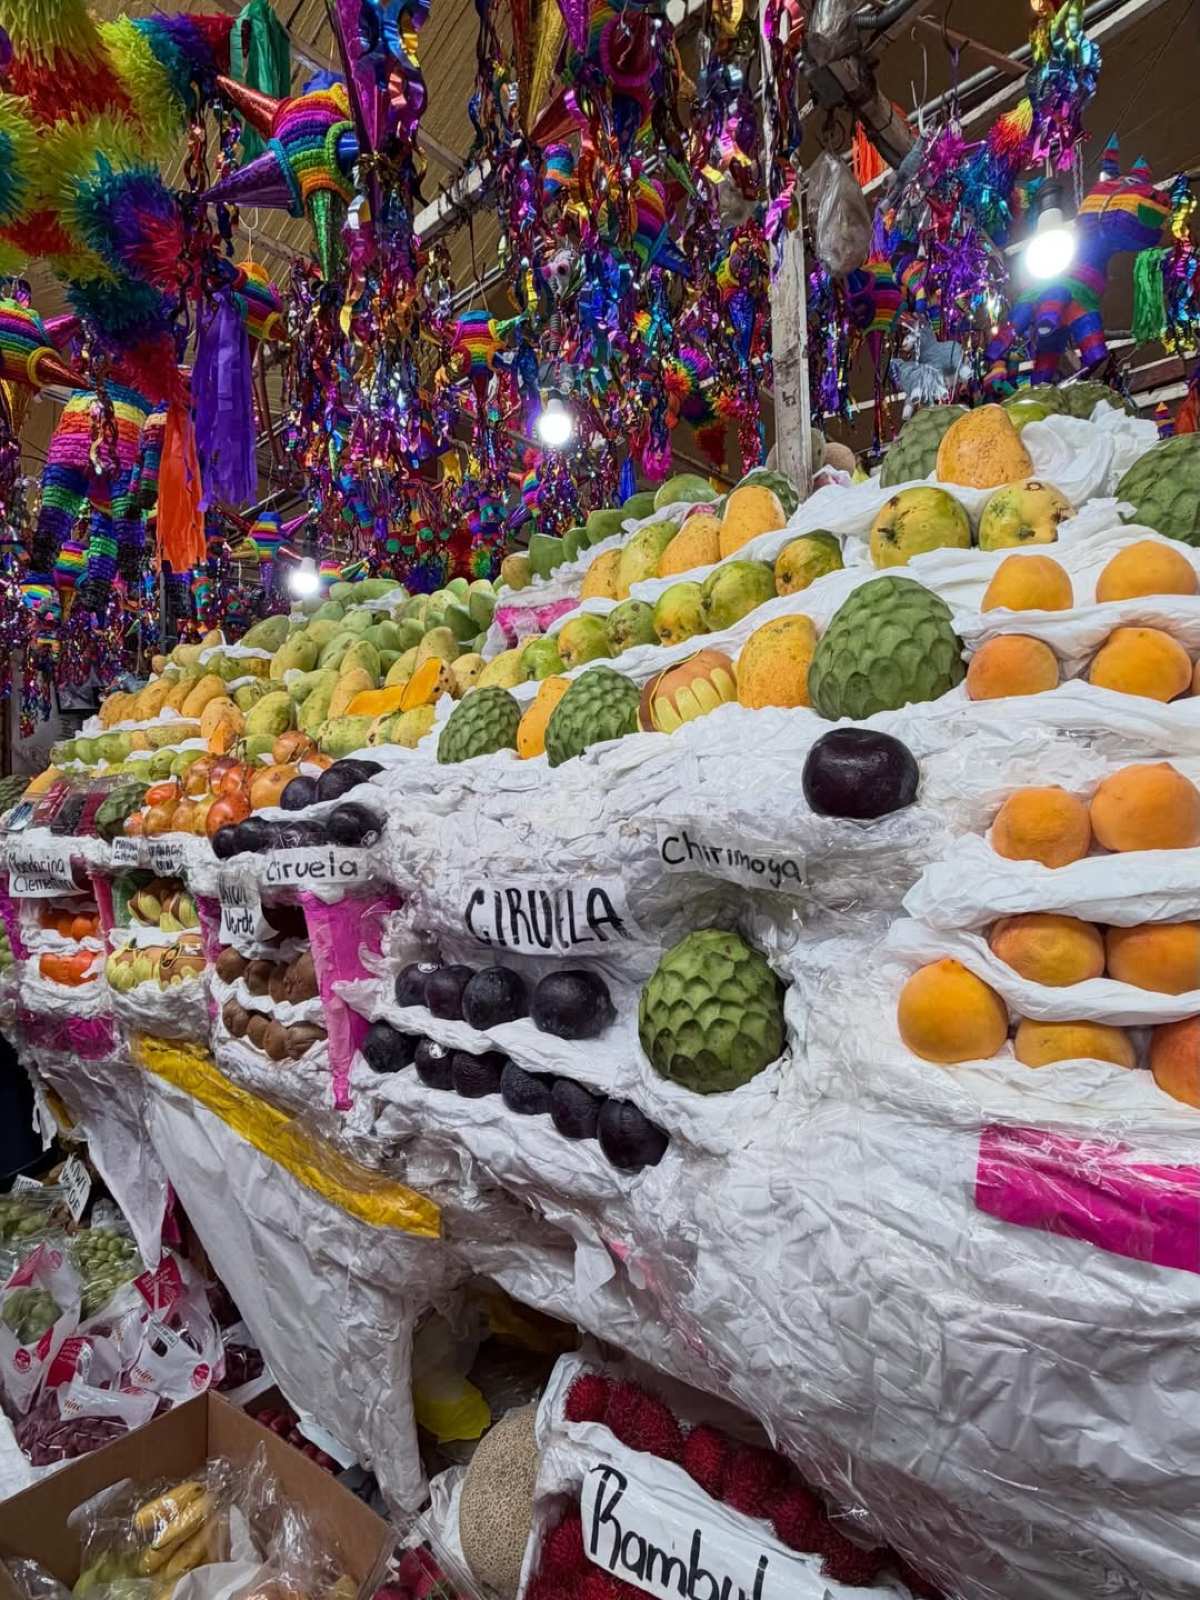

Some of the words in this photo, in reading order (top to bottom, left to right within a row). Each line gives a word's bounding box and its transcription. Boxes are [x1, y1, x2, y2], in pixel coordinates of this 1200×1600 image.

[265, 850, 359, 882] Ciruela
[660, 831, 803, 888] Chirimoya
[223, 906, 255, 935] Verde
[464, 886, 634, 949] CIRUELA
